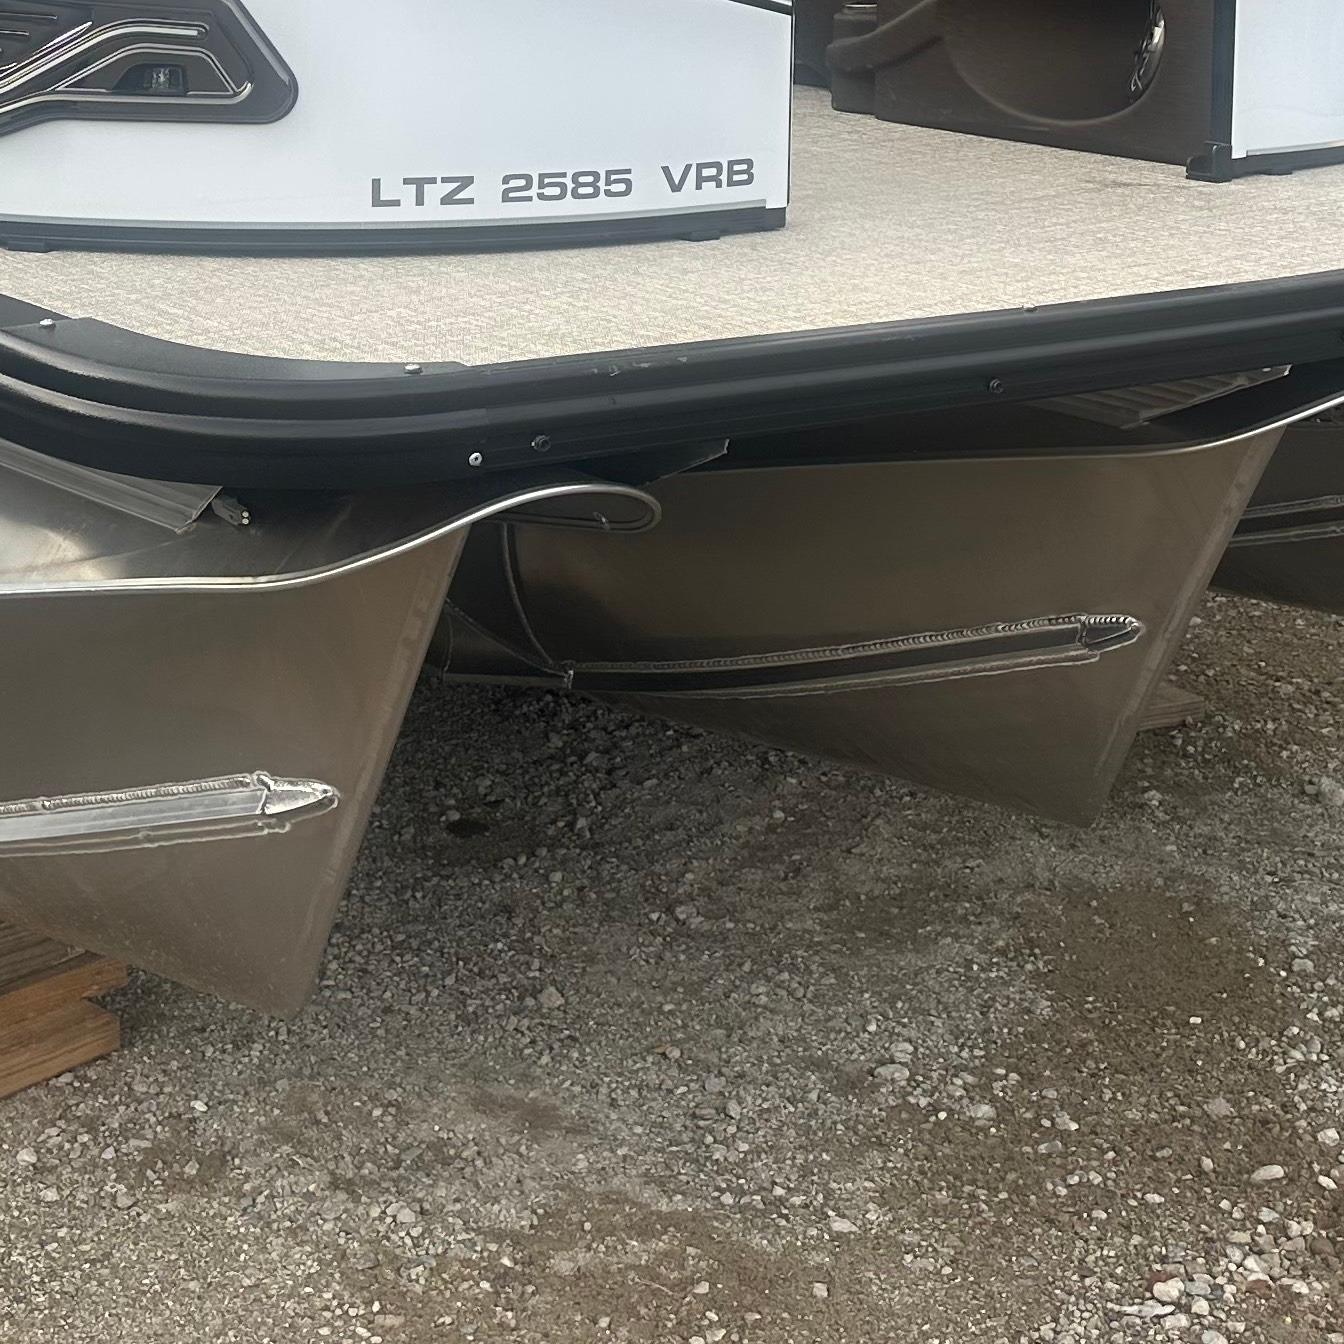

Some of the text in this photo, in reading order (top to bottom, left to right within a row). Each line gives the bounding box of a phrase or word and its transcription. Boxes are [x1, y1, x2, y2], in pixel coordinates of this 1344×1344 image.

[371, 157, 755, 208] LTZ 2585 VRB
